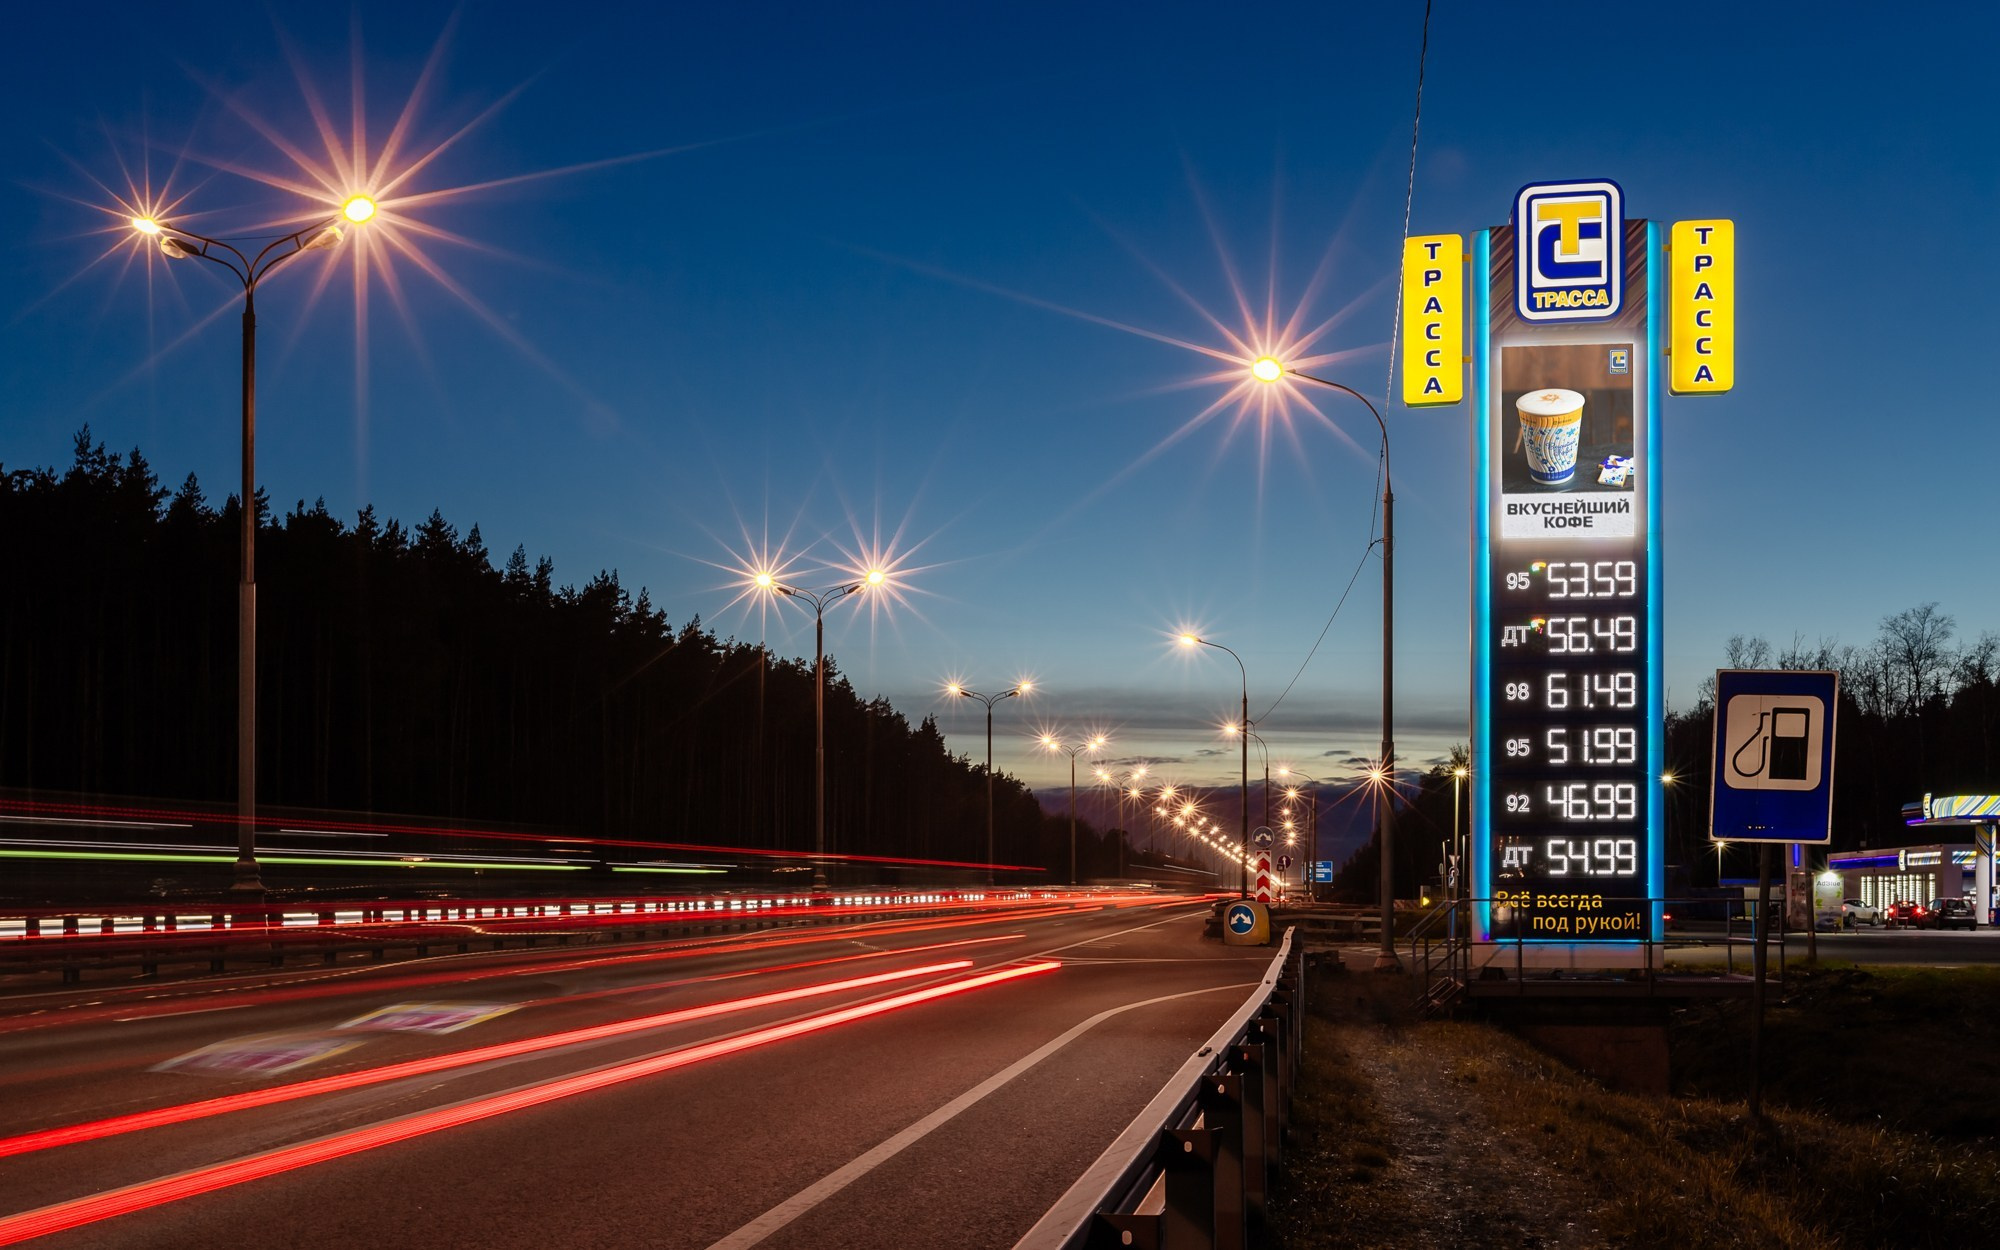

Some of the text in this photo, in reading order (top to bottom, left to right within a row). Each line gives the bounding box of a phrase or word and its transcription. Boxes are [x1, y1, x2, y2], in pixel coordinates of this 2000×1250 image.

[1532, 289, 1609, 309] ТРАССА
[1693, 227, 1715, 383] ТРАССА
[1423, 242, 1444, 395] ТРАССА
[1507, 499, 1630, 515] ВКУСНЕЙШИЙ
[1544, 516, 1593, 529] КОФЕ
[1506, 561, 1636, 598] 95 53.59
[1501, 616, 1636, 653] ДТ 56.49
[1506, 672, 1636, 709] 98 61.49
[1506, 728, 1636, 763] 95 51.99
[1506, 784, 1636, 819] 92 46.99
[1502, 839, 1636, 875] ДТ 54.99
[1497, 891, 1603, 911] Всё всегда
[1533, 912, 1641, 934] под рукой!
